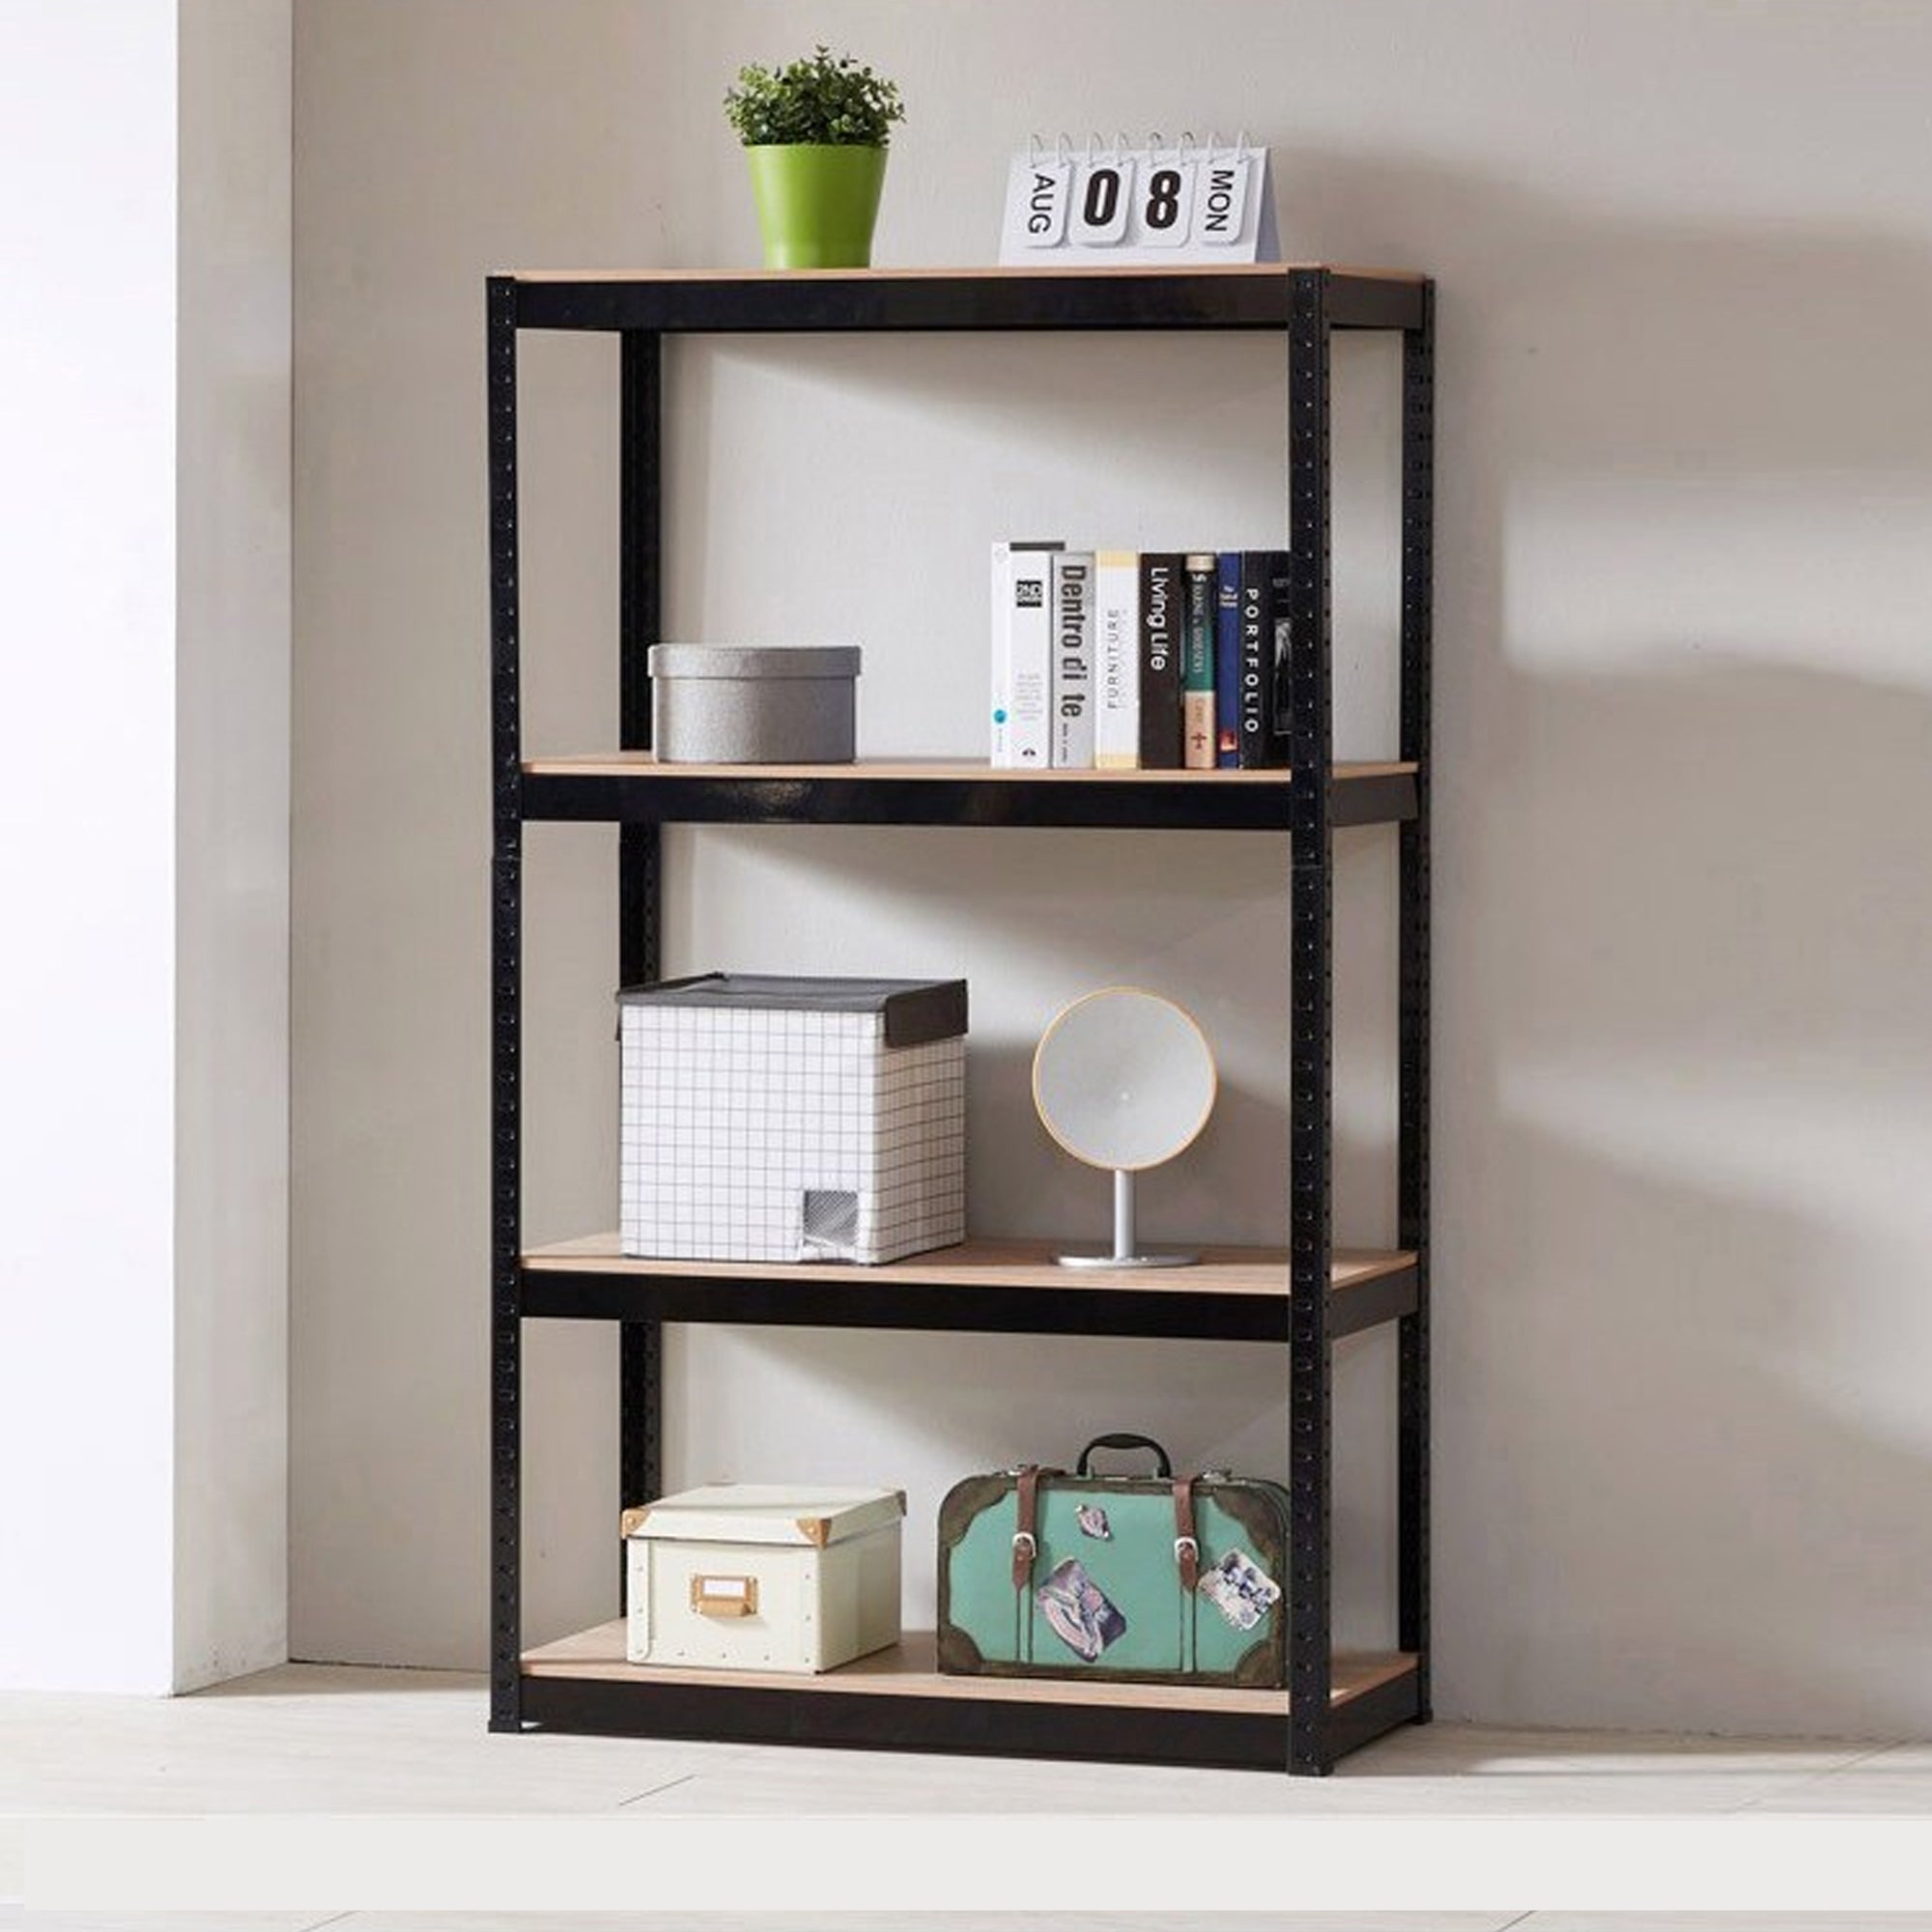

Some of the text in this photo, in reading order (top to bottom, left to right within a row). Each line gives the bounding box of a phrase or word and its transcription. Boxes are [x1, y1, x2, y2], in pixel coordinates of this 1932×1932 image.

[1028, 174, 1056, 234] AUG
[1206, 169, 1235, 232] MON
[1061, 565, 1088, 718] Dentro di te
[1107, 609, 1120, 709] FURNITURE
[1147, 567, 1169, 670] Living Life
[1244, 588, 1260, 733] PORTFOLIO
